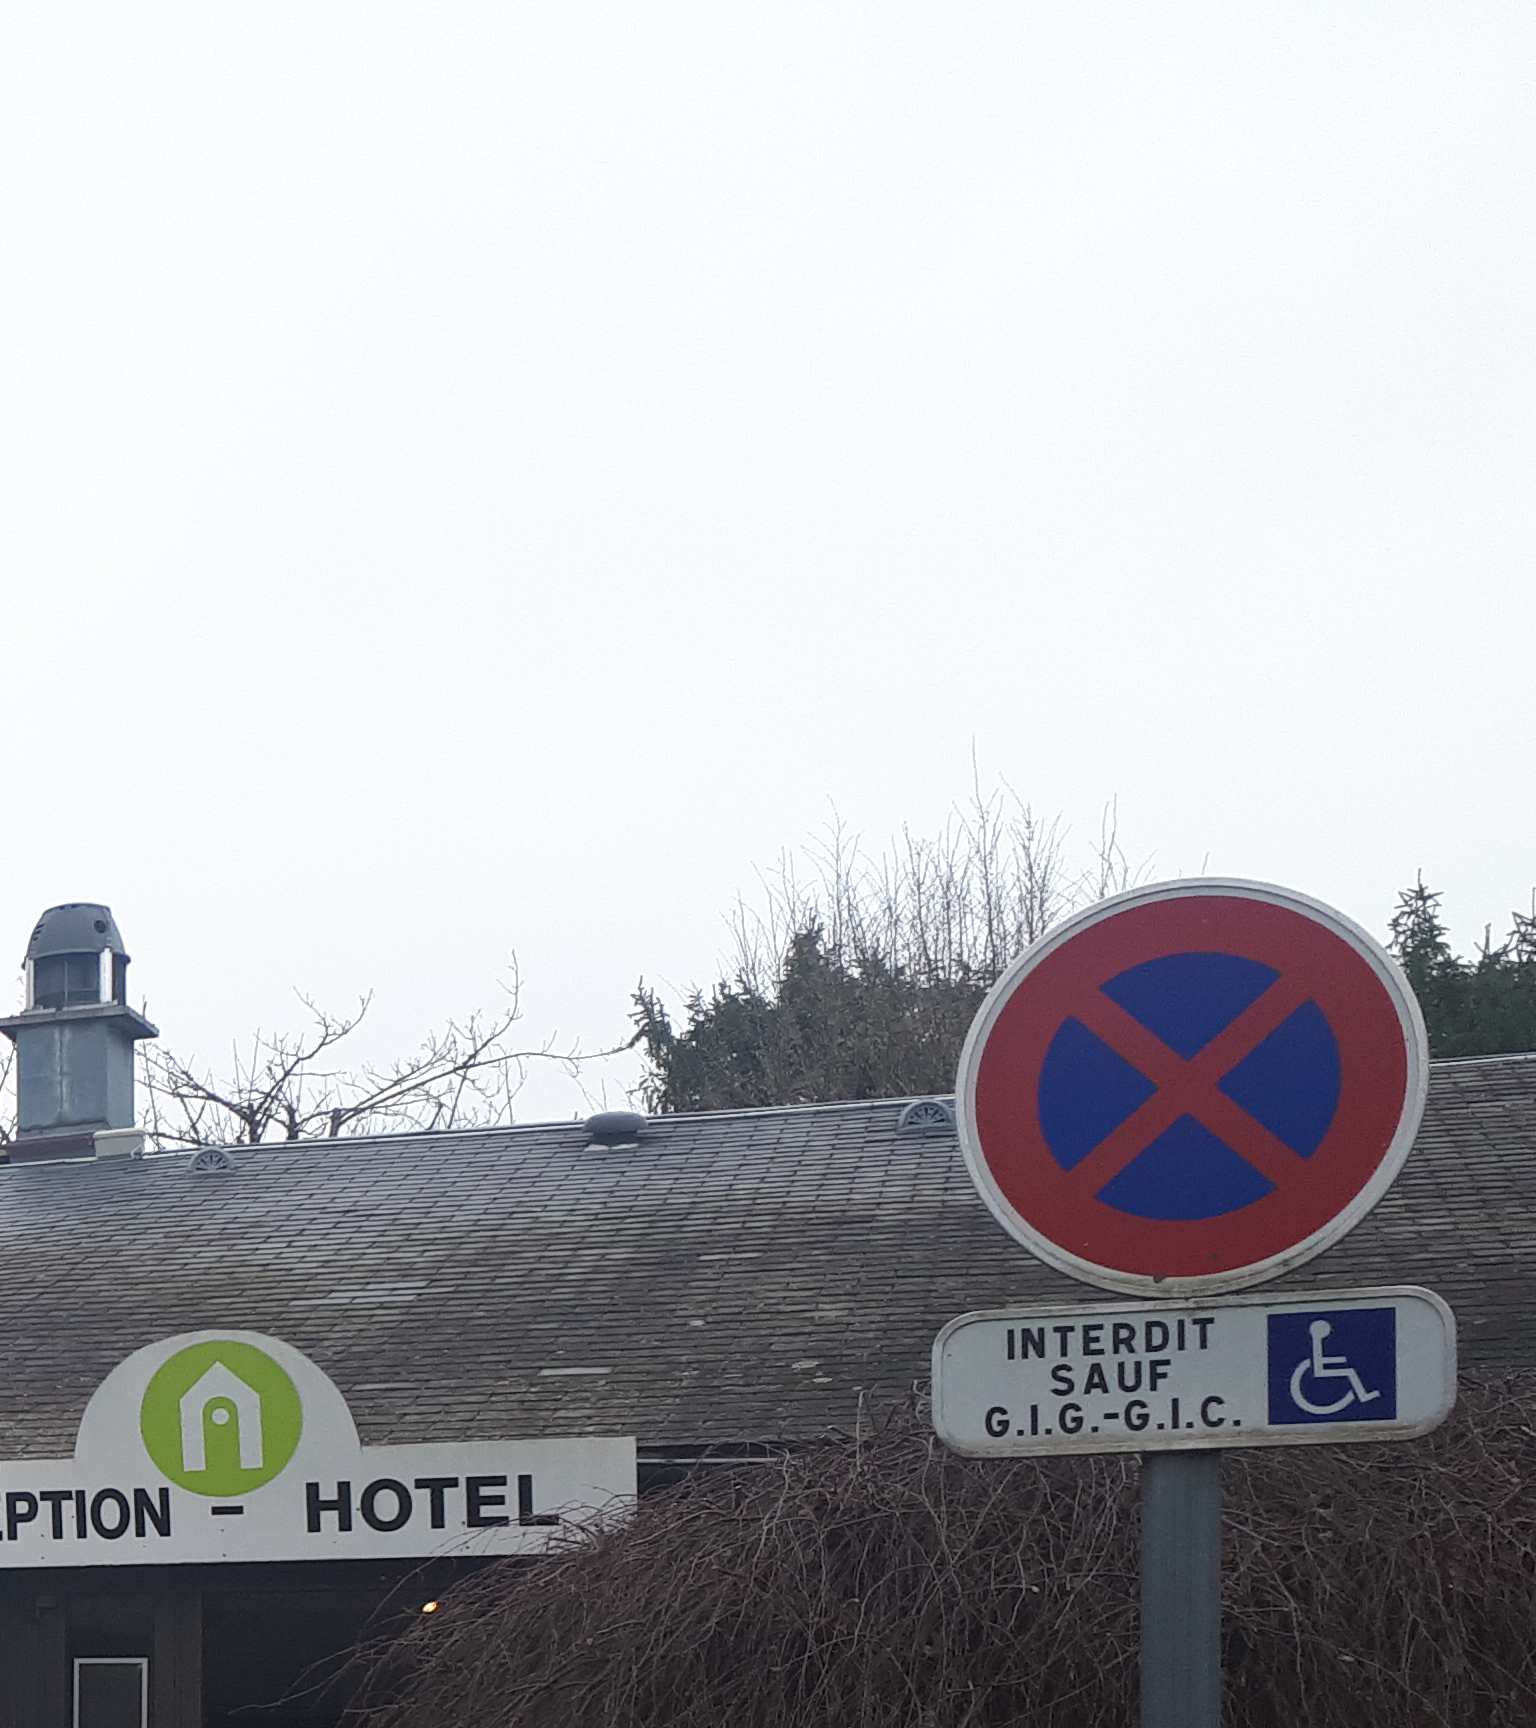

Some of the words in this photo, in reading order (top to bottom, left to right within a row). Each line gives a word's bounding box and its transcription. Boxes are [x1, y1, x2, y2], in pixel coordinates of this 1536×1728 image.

[1006, 1317, 1216, 1361] INTERDIT
[1050, 1359, 1171, 1397] SAUF
[985, 1397, 1242, 1438] G.I.G.-G.I.C.
[306, 1474, 560, 1533] HOTEL
